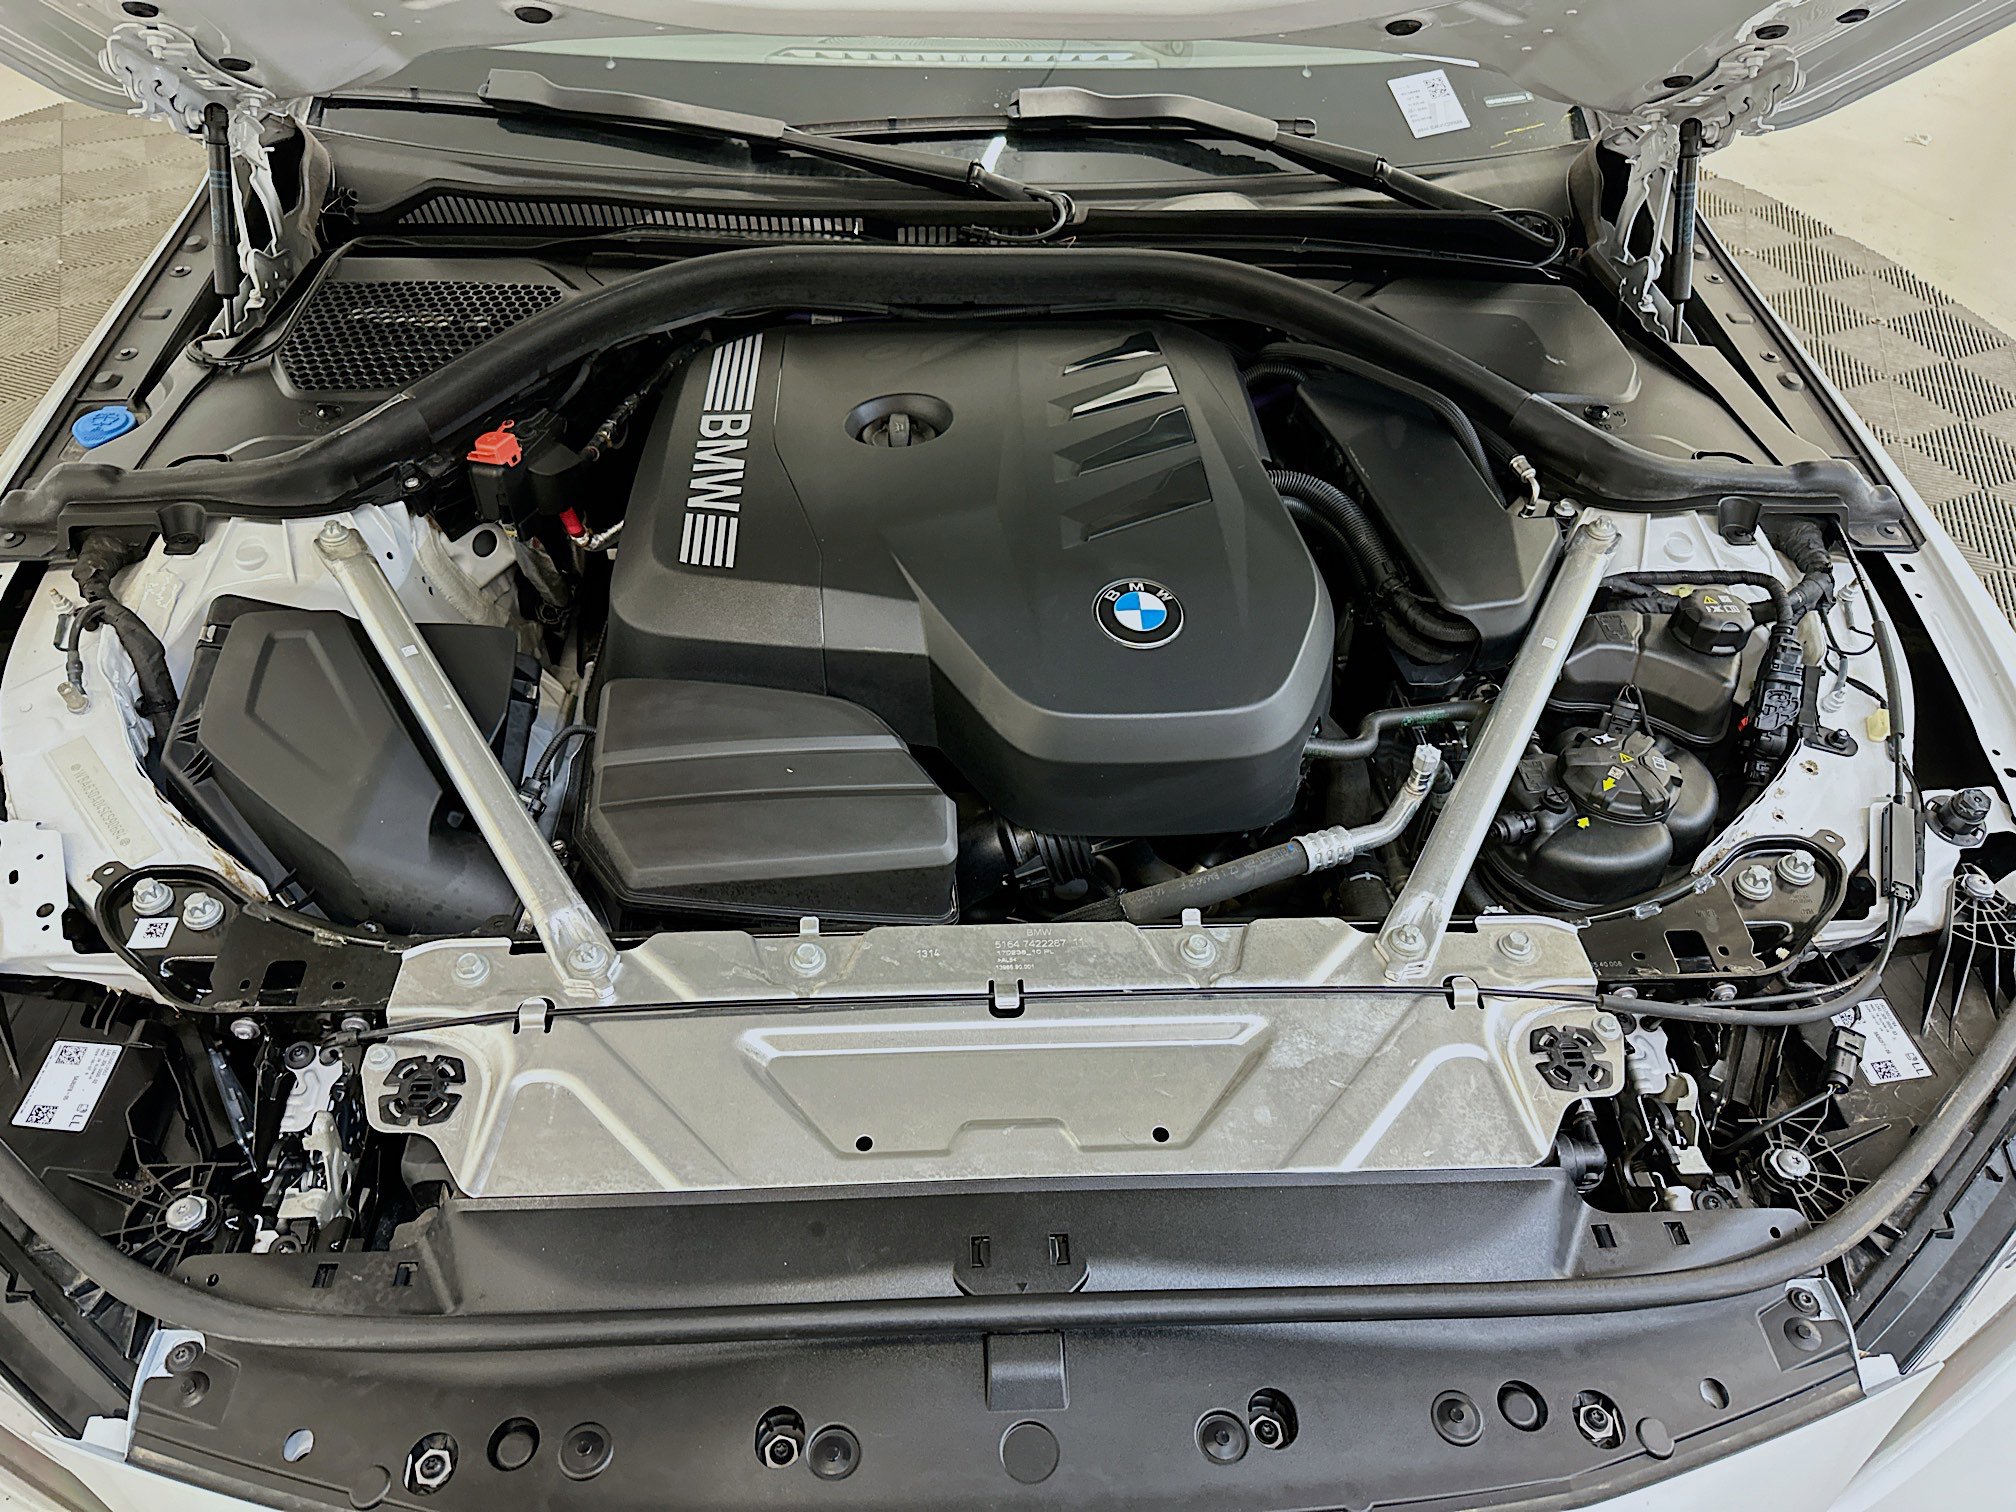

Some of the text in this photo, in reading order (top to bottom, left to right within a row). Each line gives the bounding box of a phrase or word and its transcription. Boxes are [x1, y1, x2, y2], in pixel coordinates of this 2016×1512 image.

[687, 413, 752, 513] BMW
[1103, 582, 1173, 602] BMW
[1026, 928, 1052, 936] BMW
[995, 940, 1020, 949] 5164
[1023, 939, 1066, 948] 7422287
[916, 949, 941, 959] 1314
